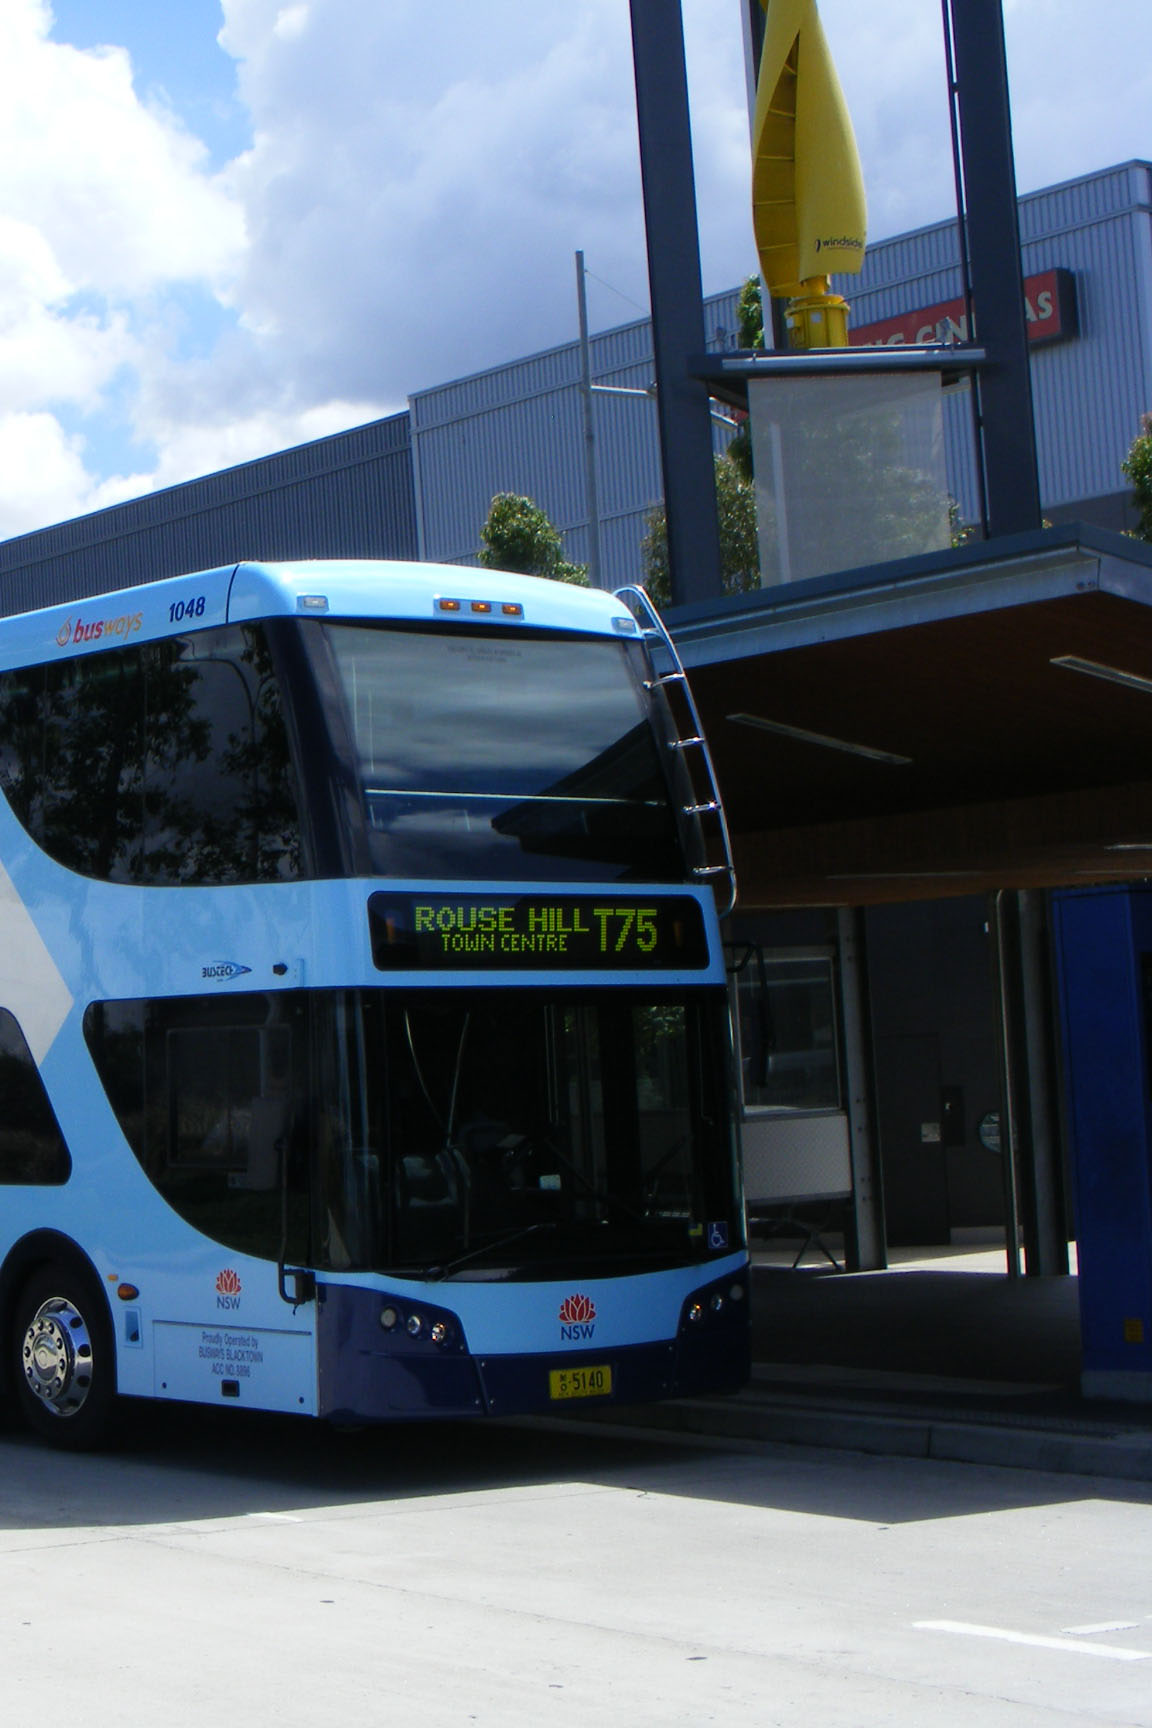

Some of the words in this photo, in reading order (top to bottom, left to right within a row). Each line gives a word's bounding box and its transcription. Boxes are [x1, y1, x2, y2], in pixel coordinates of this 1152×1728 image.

[169, 597, 206, 622] 1048
[72, 612, 143, 644] busways
[415, 906, 514, 931] ROUSE
[528, 907, 590, 932] HILL
[593, 909, 658, 952] T75
[441, 934, 494, 952] TOWN
[500, 934, 568, 952] CENTRE
[216, 1297, 241, 1310] NSW
[561, 1325, 595, 1340] NSW
[572, 1371, 603, 1390] 5140
